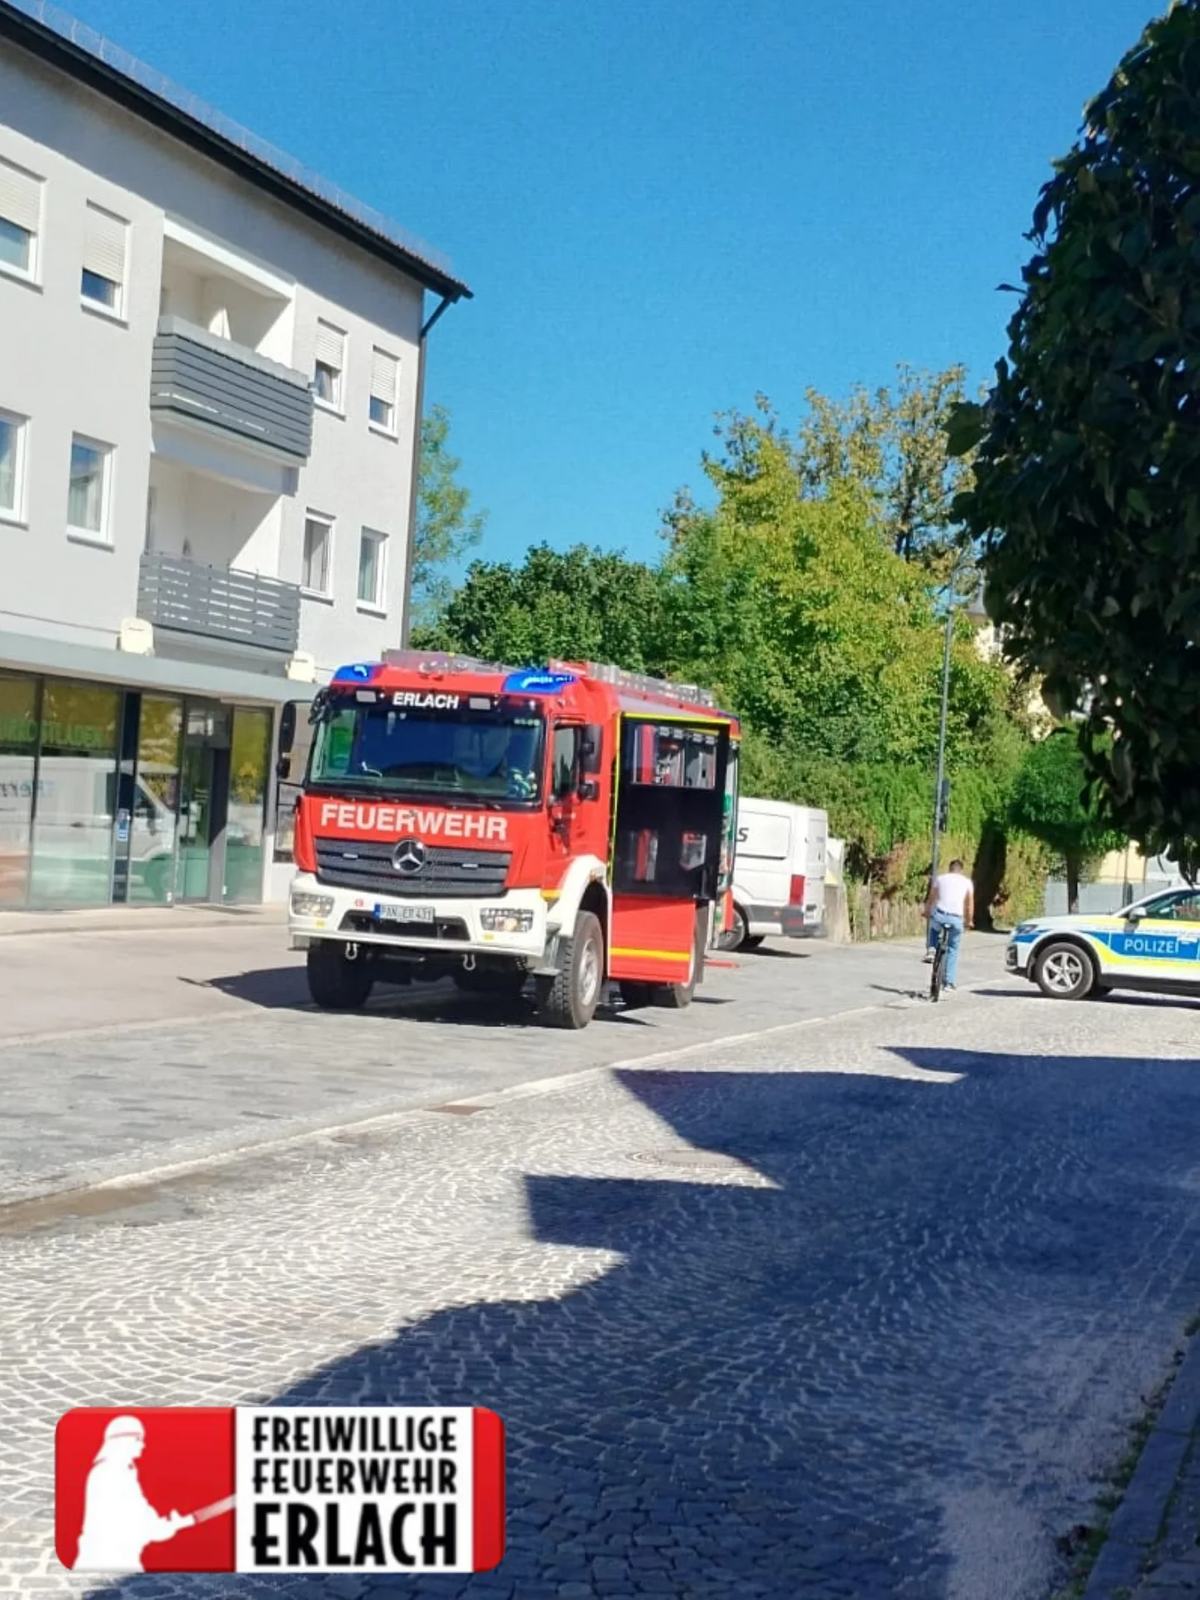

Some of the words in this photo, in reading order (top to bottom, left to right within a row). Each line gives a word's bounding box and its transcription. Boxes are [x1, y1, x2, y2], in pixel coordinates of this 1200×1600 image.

[393, 692, 459, 709] ERLACH
[320, 804, 507, 840] FEUERWEHR
[1124, 938, 1180, 954] POLIZEI
